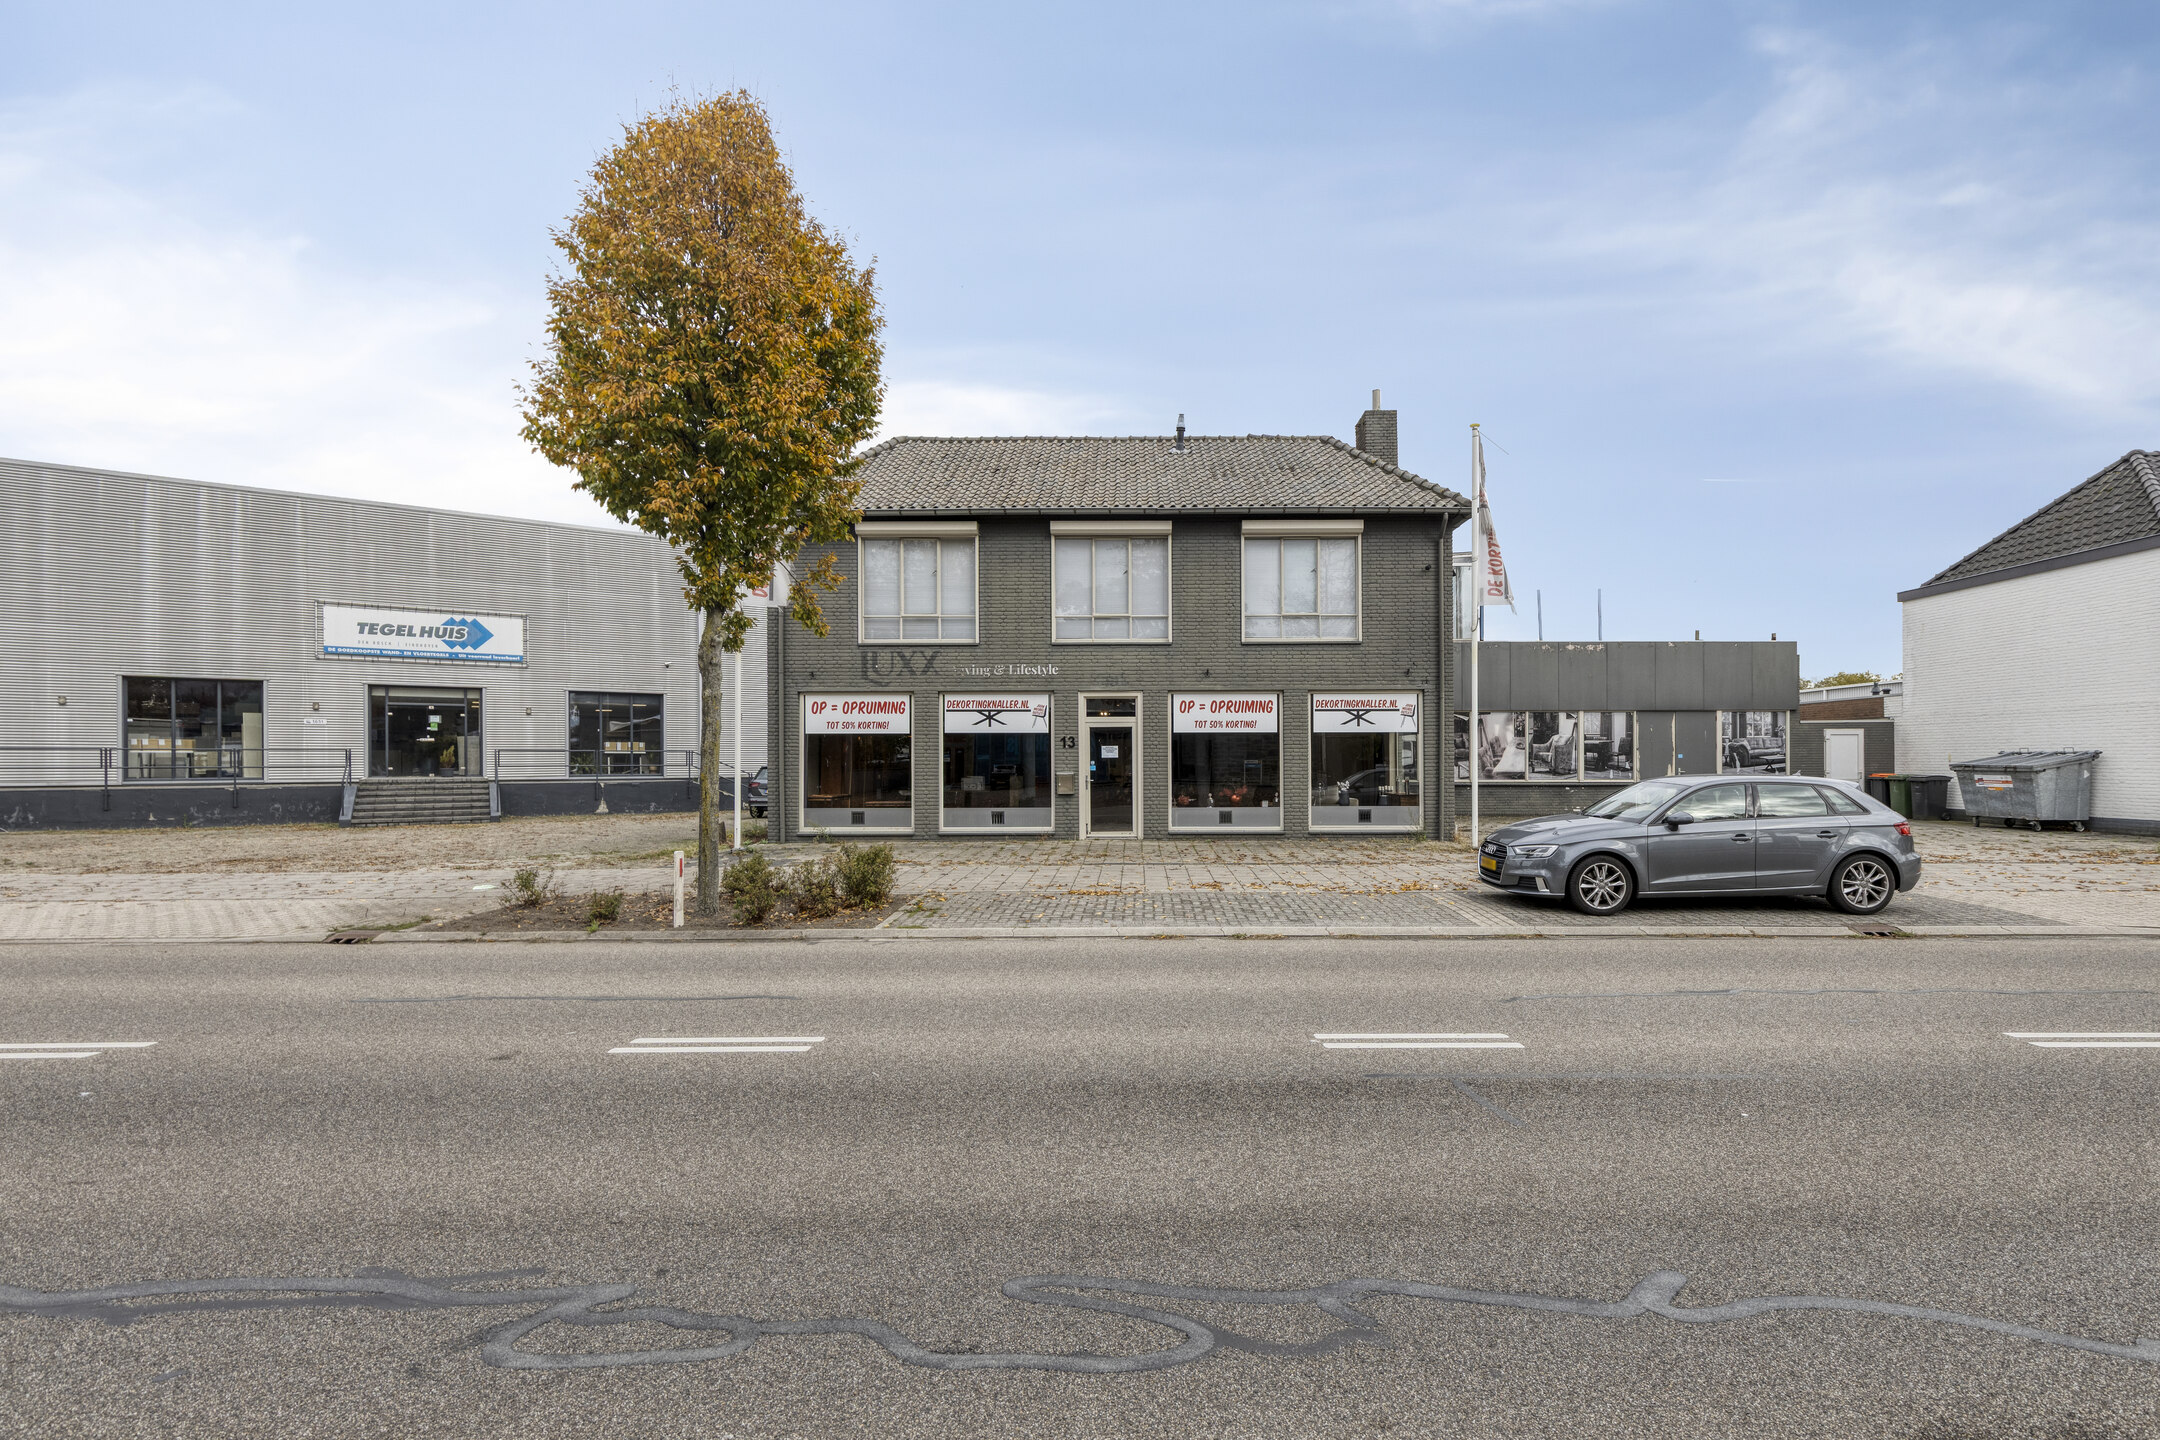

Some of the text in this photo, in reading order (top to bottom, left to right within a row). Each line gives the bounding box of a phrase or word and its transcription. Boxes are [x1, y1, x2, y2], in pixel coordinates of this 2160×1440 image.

[1488, 526, 1503, 597] DE KORT
[337, 647, 380, 655] GOEDKOOPSTE
[993, 664, 1006, 676] &
[1009, 664, 1059, 677] Lifestyle
[811, 701, 827, 715] OP
[842, 701, 906, 715] OPRUIMING
[946, 699, 1030, 709] DEKORTINGKNALLER.NL
[1179, 700, 1195, 714] OP
[1210, 700, 1274, 714] OPRUIMING
[1315, 699, 1399, 709] DEKORTINGKNALLER.NL
[826, 721, 890, 730] TOT 50% KORTING!
[1194, 720, 1258, 729] TOT 50% KORTING!
[1060, 736, 1076, 749] 13
